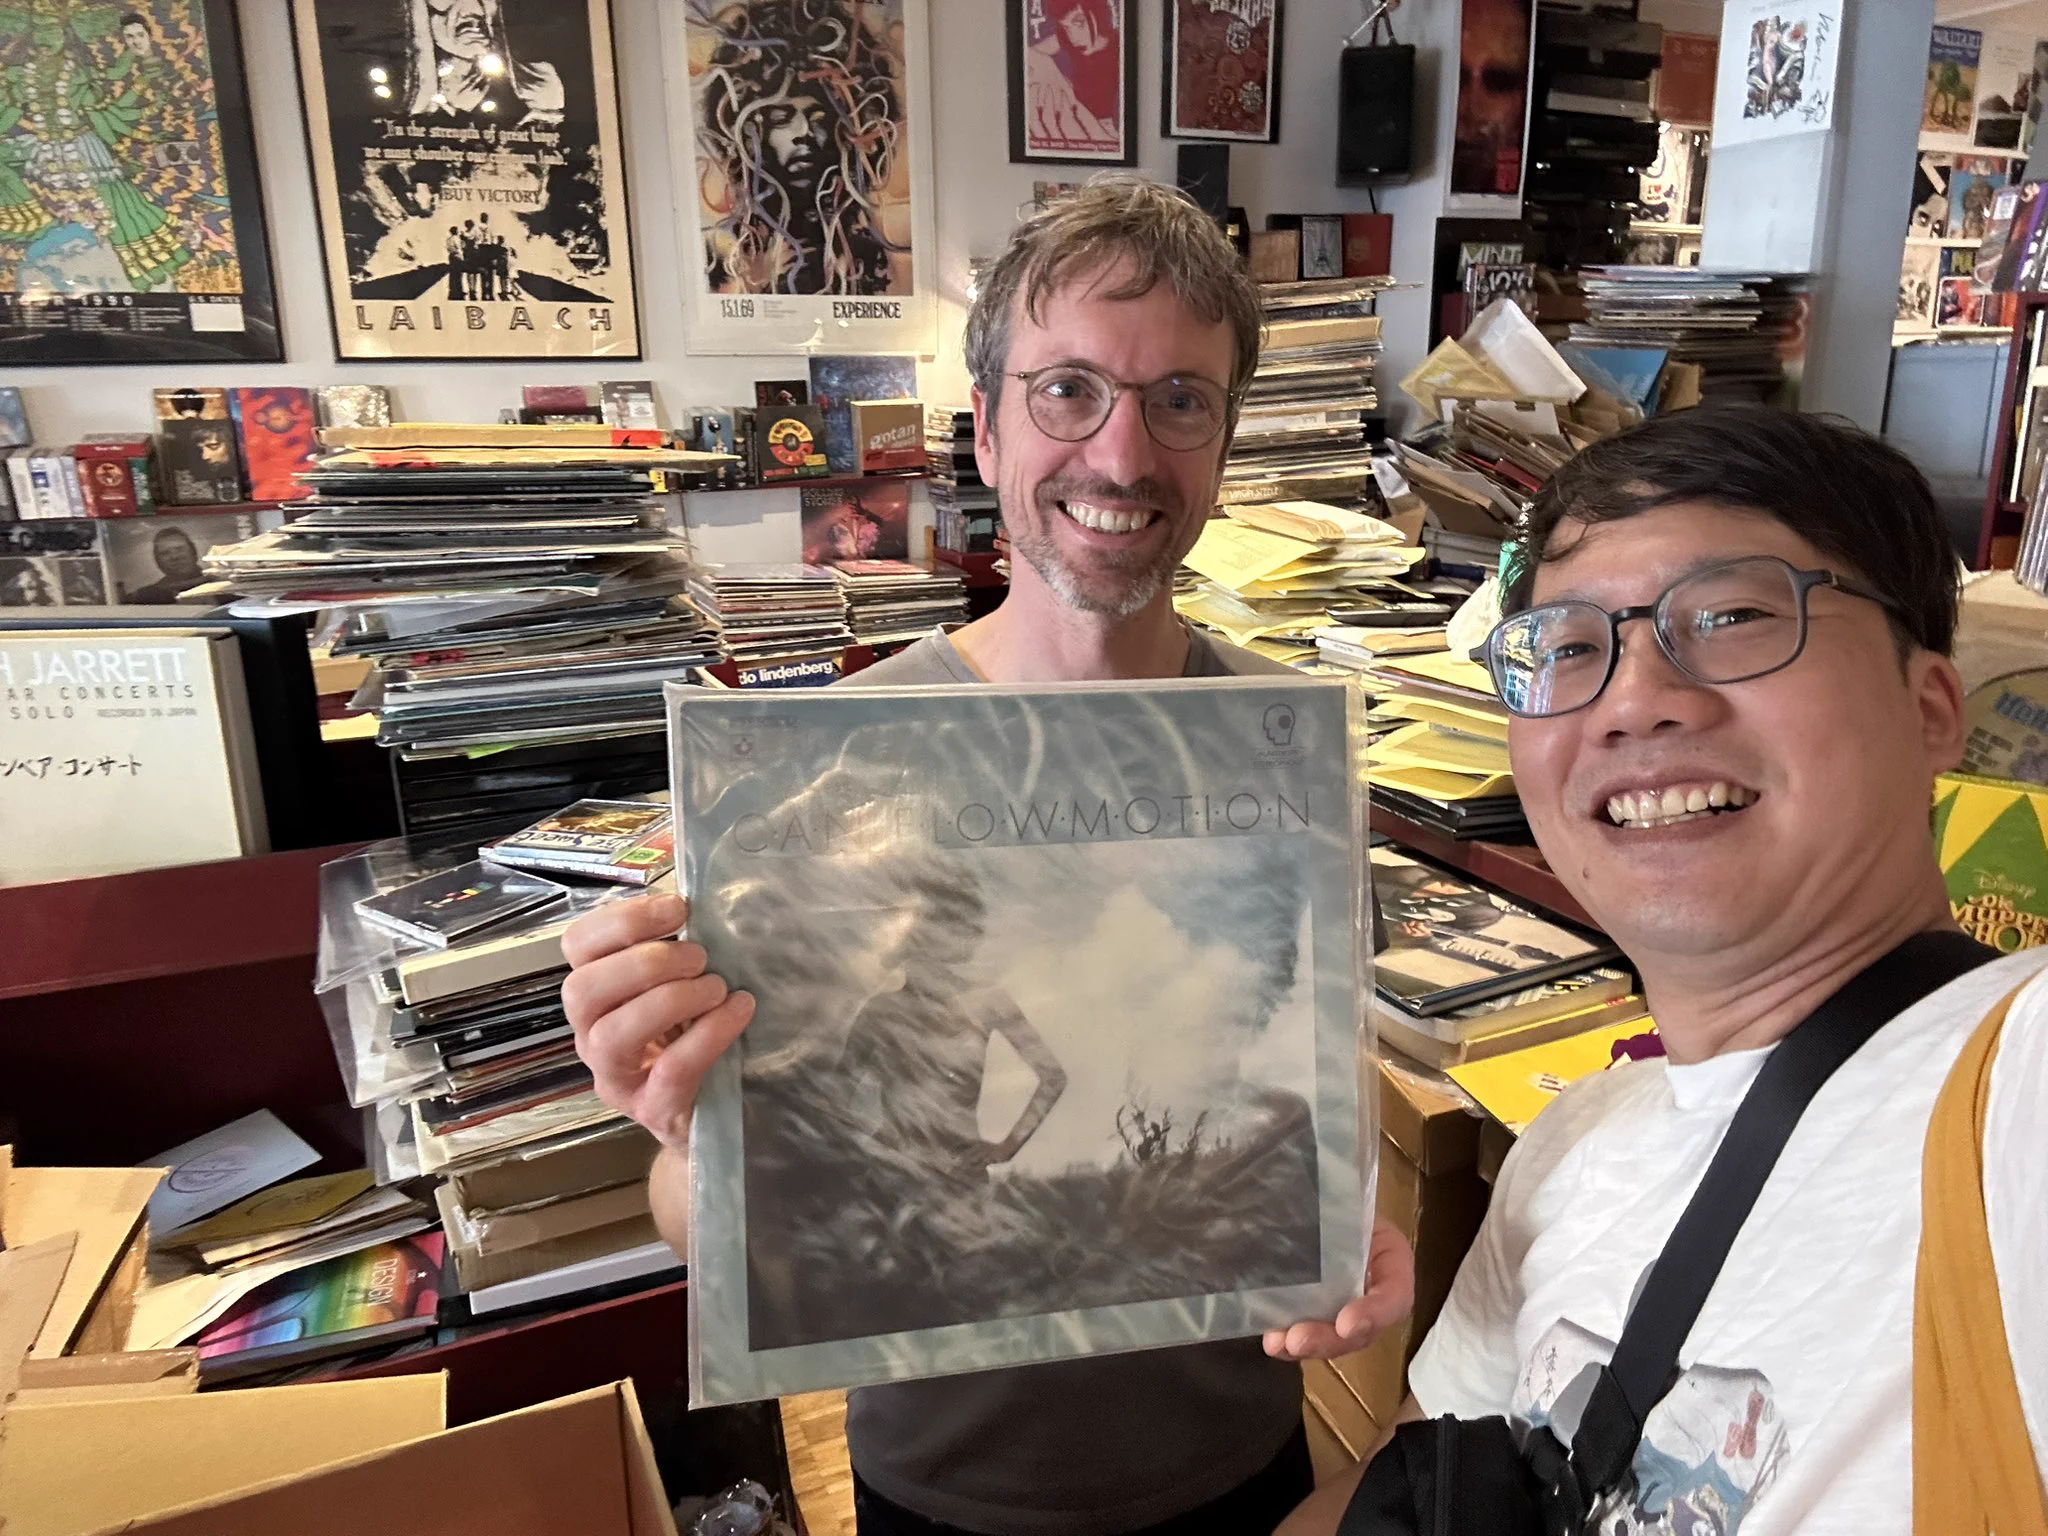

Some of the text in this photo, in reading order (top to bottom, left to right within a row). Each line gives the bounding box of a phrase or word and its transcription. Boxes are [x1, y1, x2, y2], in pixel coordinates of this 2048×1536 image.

[442, 187, 541, 204] BUY VICTORY
[355, 305, 613, 331] LAIBACH
[832, 301, 902, 319] EXPERIENCE
[27, 647, 187, 686] JARRETT
[759, 661, 833, 682] lindenberg
[59, 684, 195, 701] CONCERTS
[10, 705, 74, 719] SOLO
[367, 1258, 399, 1307] DESIGN
